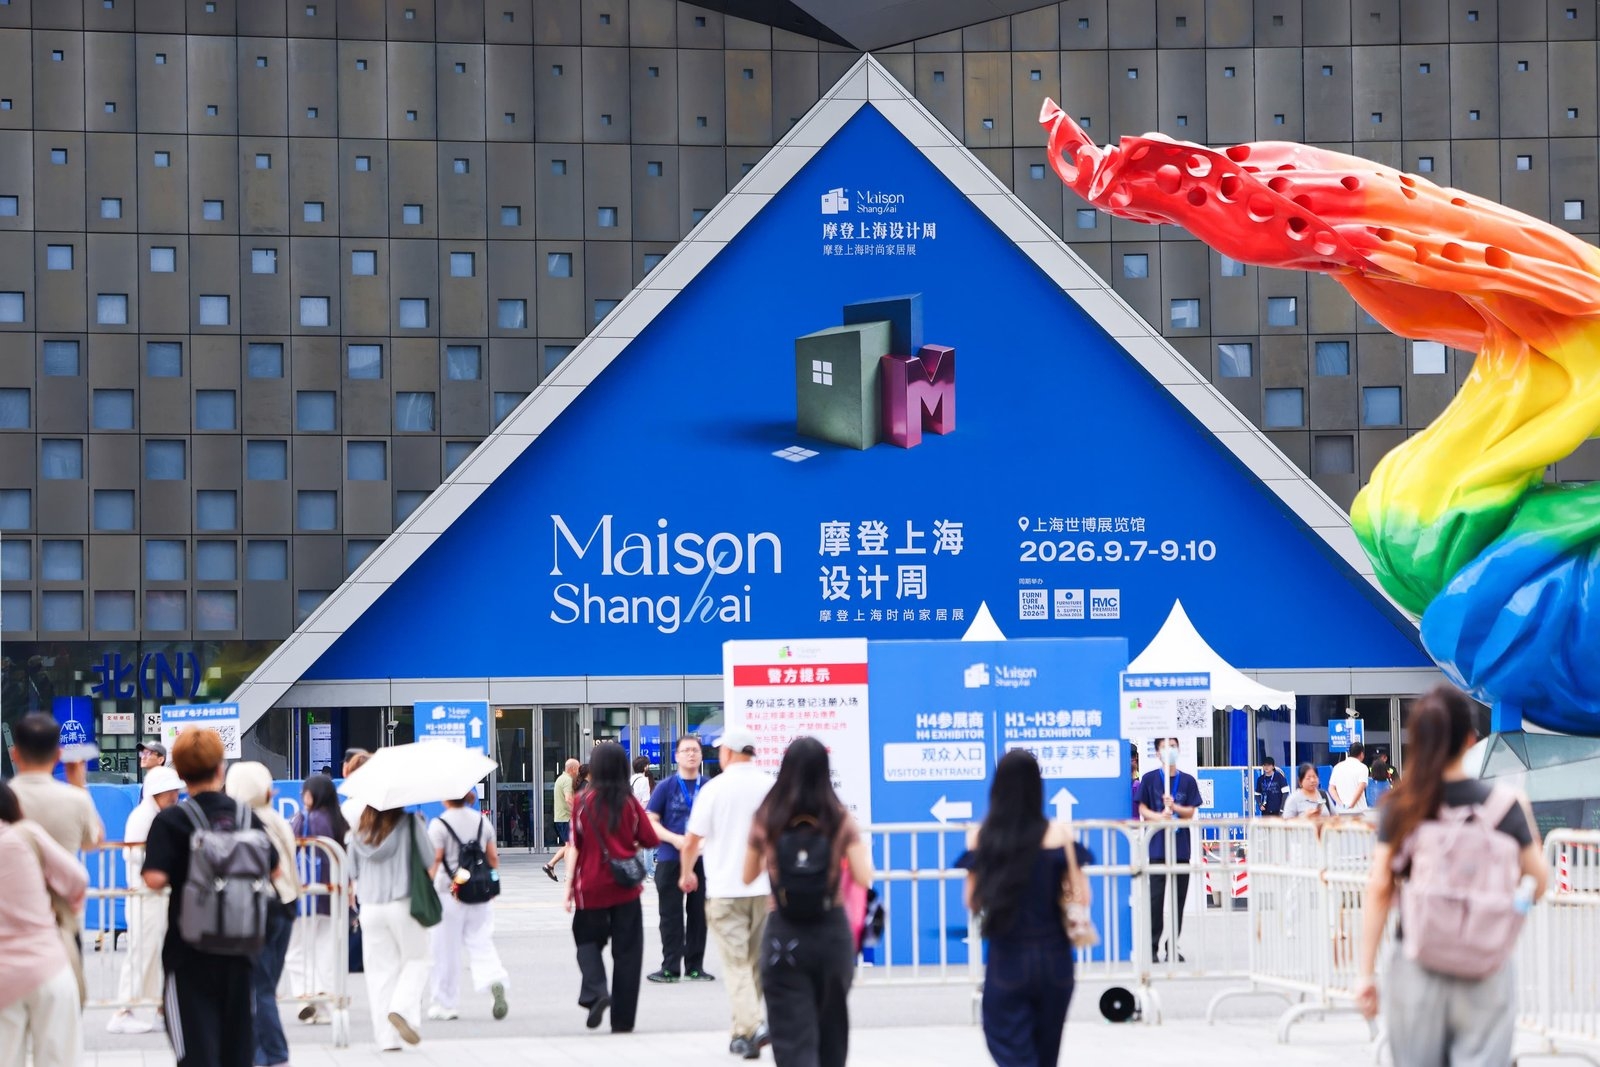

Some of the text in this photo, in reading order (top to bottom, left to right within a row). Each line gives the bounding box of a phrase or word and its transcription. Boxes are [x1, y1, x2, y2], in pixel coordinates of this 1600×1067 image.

[857, 190, 905, 204] Maison
[823, 222, 937, 240] 摩登上海设计周
[823, 244, 917, 256] 摩登上海时尚家居展
[1033, 517, 1146, 533] 上海世博展览馆
[550, 514, 782, 576] Maison
[819, 519, 965, 556] 摩登上海
[1019, 540, 1217, 562] 2026.9.7-9.10
[819, 565, 928, 601] 设计周
[550, 555, 751, 633] Shanghai
[1092, 597, 1118, 607] FMC
[819, 608, 965, 622] 摩登上海时尚家居展
[767, 668, 831, 684] 警方提示
[916, 711, 984, 729] H4参展商
[916, 729, 984, 740] H4 EXHIBITOR
[1038, 727, 1092, 738] EXHIBITOR
[922, 747, 982, 762] 观众入口
[1011, 744, 1115, 760] 内尊享买家卡
[886, 767, 983, 778] VISITOR ENTRANCE
